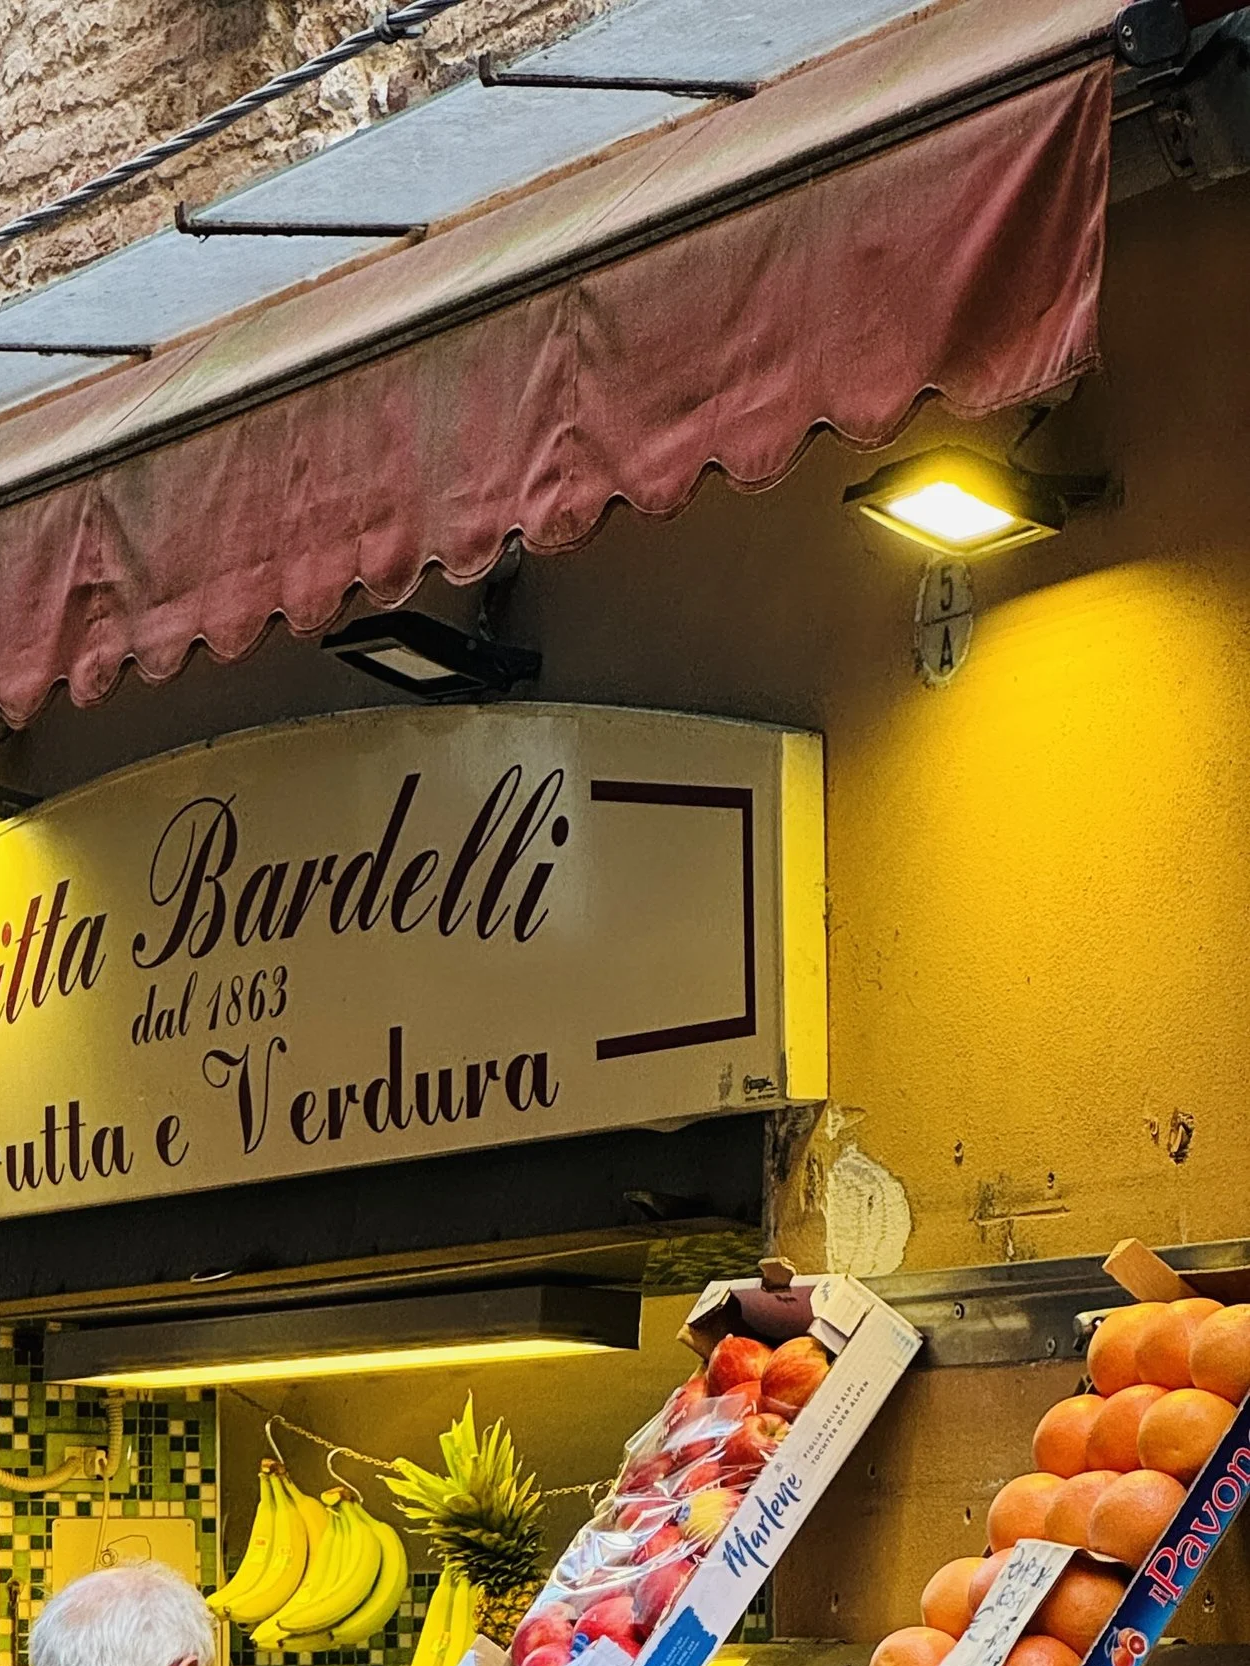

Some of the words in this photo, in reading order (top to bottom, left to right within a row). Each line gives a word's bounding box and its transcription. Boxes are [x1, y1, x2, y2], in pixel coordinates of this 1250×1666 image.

[132, 764, 570, 968] Bardelli
[131, 982, 190, 1045] dal
[207, 965, 288, 1032] 1863
[156, 1115, 188, 1166] e
[203, 1025, 560, 1155] Verdura
[722, 1472, 802, 1577] Marlene
